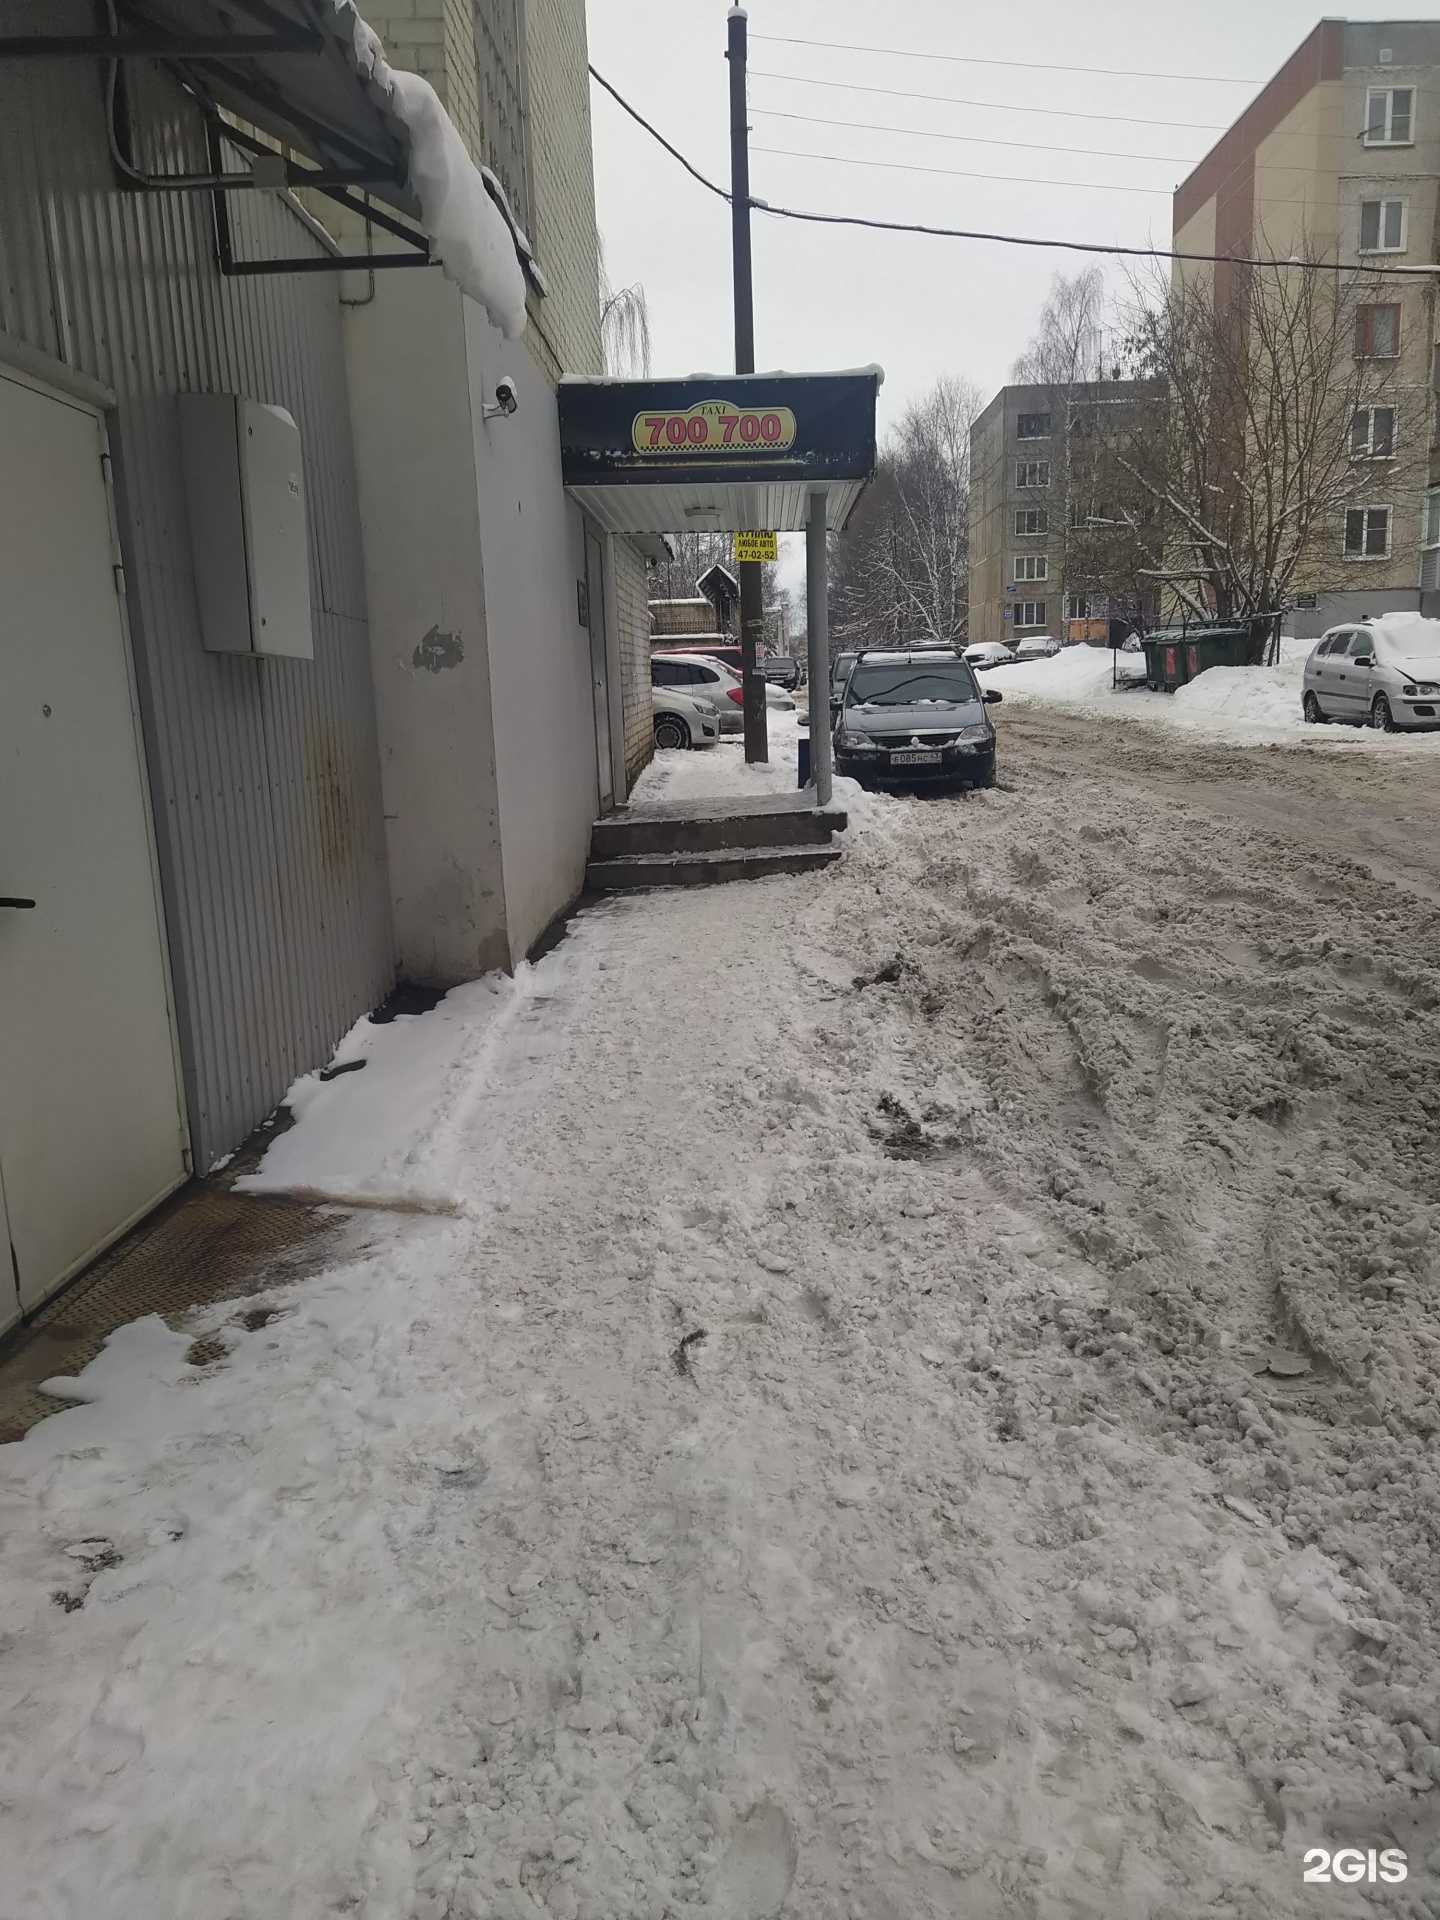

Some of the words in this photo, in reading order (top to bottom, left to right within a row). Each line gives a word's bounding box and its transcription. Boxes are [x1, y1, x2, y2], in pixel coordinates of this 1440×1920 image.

[701, 406, 726, 415] TAXI
[644, 416, 708, 444] 700
[718, 414, 781, 442] 700
[738, 539, 758, 548] ЛЮБОЕ
[760, 539, 774, 548] АВТО
[738, 551, 775, 560] 47-02-52
